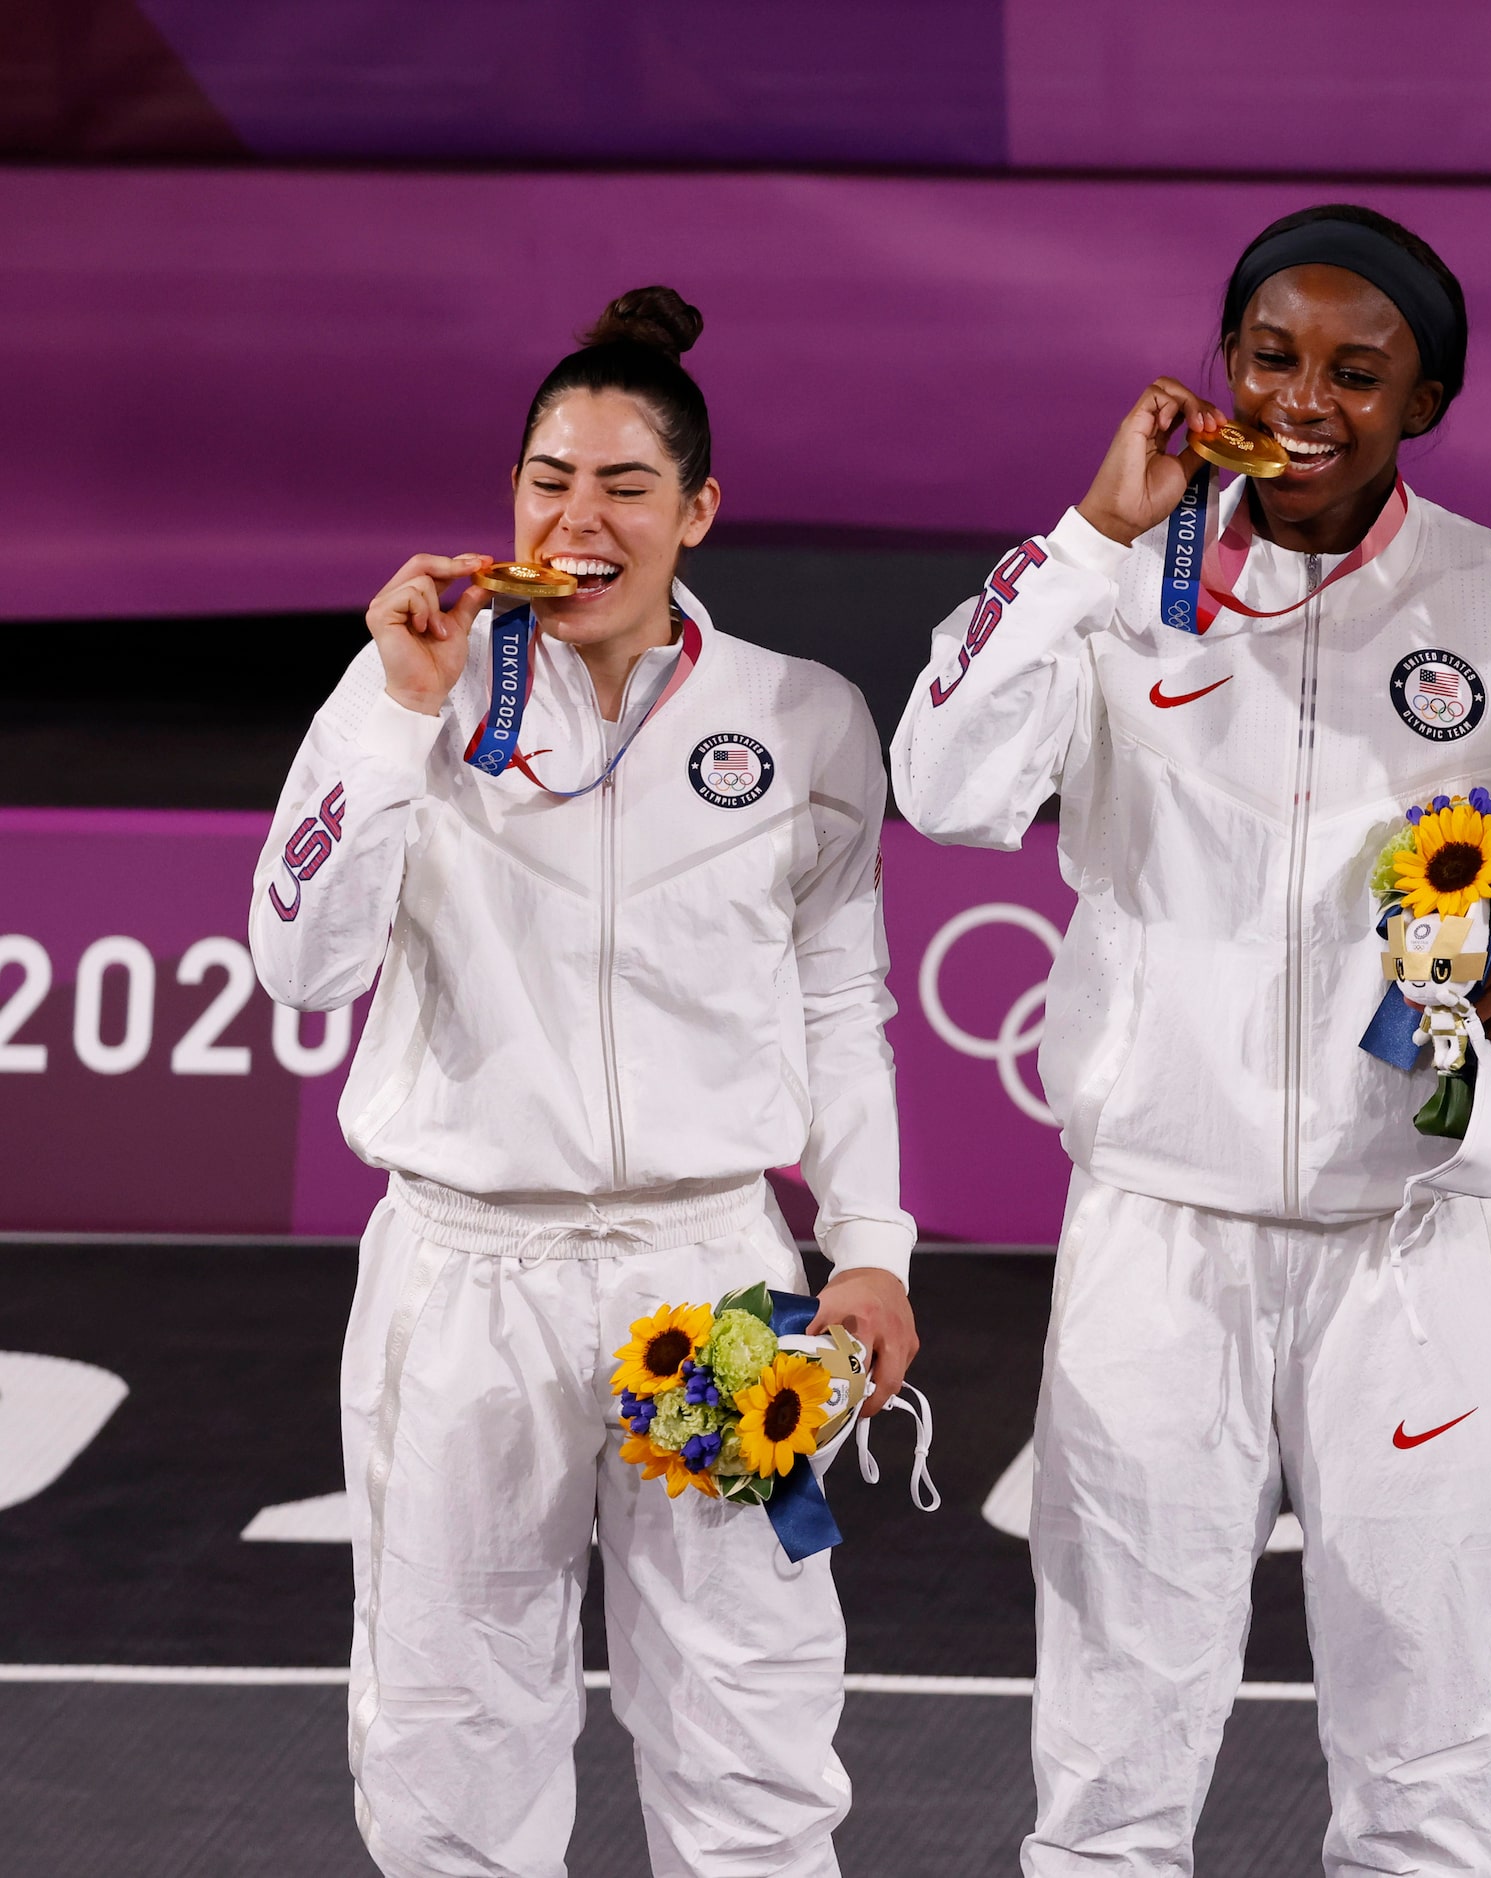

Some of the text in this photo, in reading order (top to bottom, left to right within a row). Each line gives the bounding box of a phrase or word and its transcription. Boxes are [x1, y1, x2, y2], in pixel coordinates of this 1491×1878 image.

[1172, 483, 1199, 591] TOKYO 2020
[929, 539, 1048, 708] USA
[1403, 653, 1476, 680] UNITED STATES
[493, 633, 519, 741] TOKYO 2020
[1403, 711, 1472, 738] OLYMPIC TEAM
[698, 736, 764, 754] UNITED STATES
[700, 786, 762, 805] OLYMPIC TEAM
